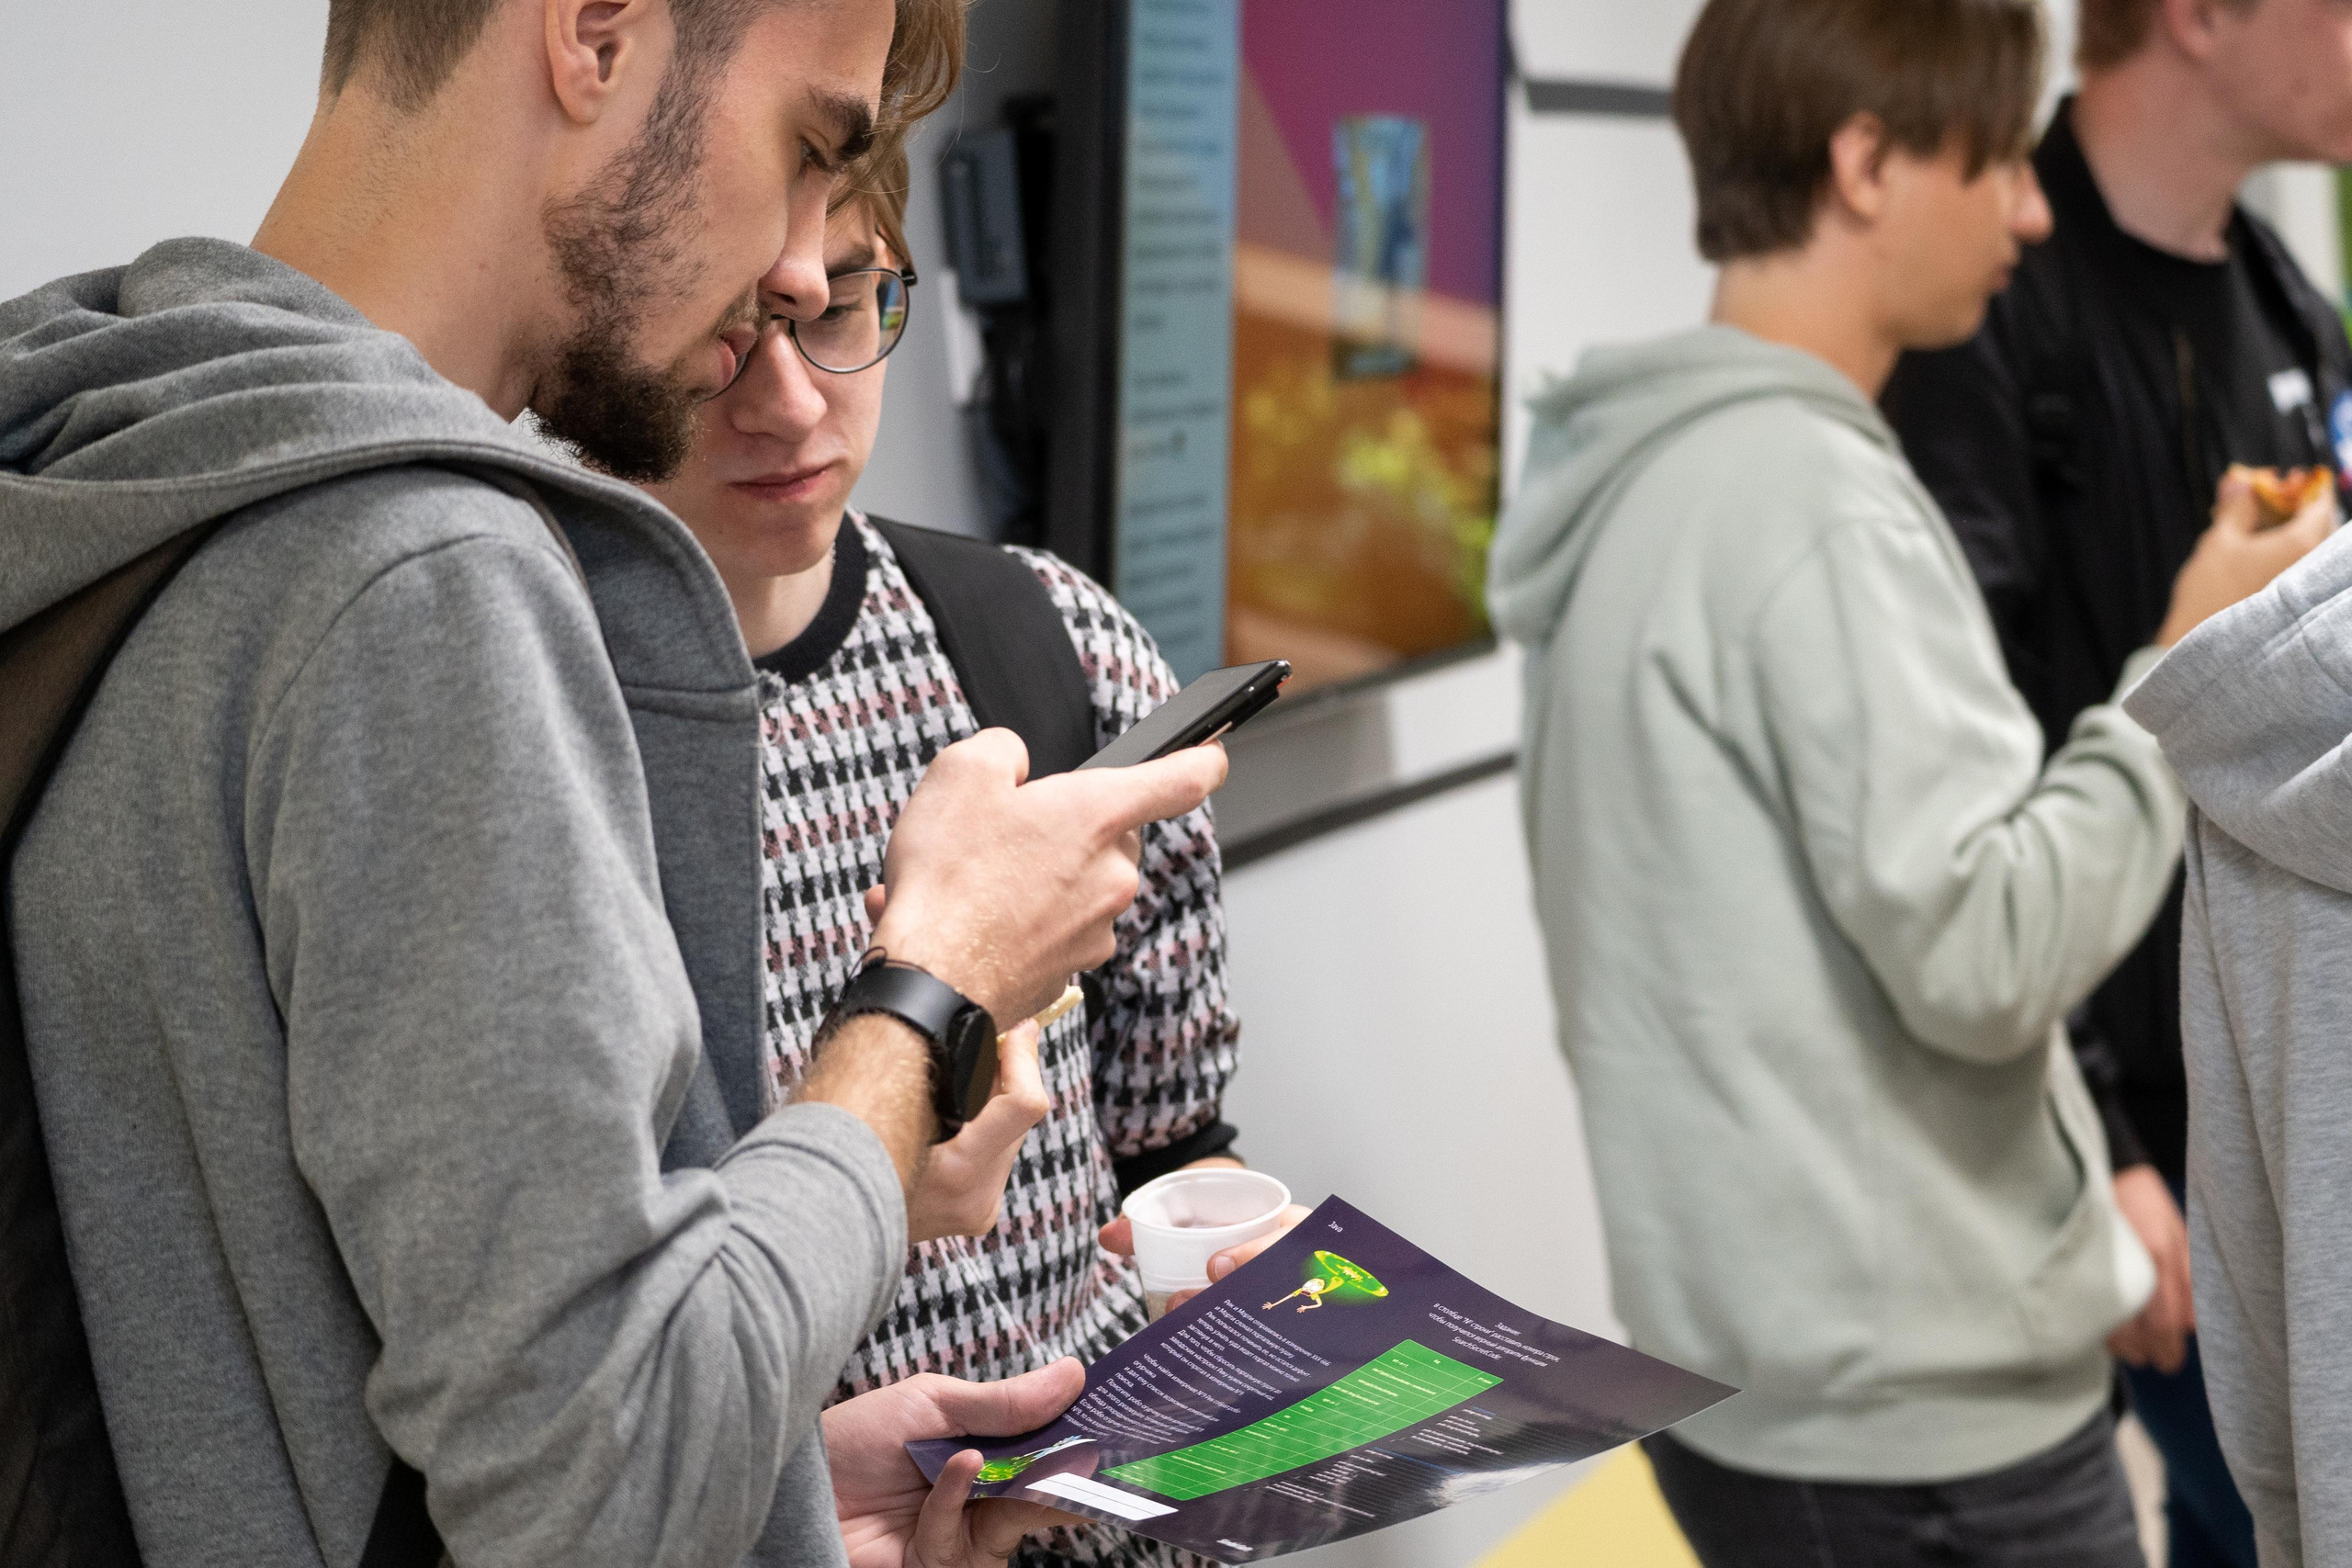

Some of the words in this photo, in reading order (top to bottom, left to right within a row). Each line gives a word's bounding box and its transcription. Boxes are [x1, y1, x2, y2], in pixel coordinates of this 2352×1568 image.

[1328, 1220, 1343, 1233] Java
[1218, 1308, 1236, 1321] Морти
[1224, 1299, 1235, 1308] Рик
[1238, 1309, 1254, 1321] Морти
[1187, 1325, 1210, 1340] заглянув
[1205, 1312, 1216, 1320] Рик
[1216, 1319, 1241, 1337] попытался
[1240, 1336, 1262, 1350] починить
[1275, 1358, 1294, 1369] остался
[1429, 1313, 1447, 1324] чтобы
[1474, 1337, 1498, 1347] верный
[1438, 1306, 1463, 1320] столбце
[1490, 1333, 1521, 1347] расставить
[1521, 1345, 1544, 1355] номера
[1160, 1342, 1182, 1359] который
[1187, 1361, 1207, 1375] спрятал
[1170, 1337, 1195, 1355] заводских
[1216, 1368, 1229, 1377] Рику
[1227, 1375, 1243, 1384] нужен
[1177, 1330, 1190, 1338] Для
[1189, 1337, 1201, 1348] того,
[1201, 1345, 1216, 1356] чтобы
[1214, 1355, 1235, 1370] сбросить
[1235, 1368, 1262, 1384] портальную
[1197, 1318, 1214, 1331] теперь
[1212, 1330, 1229, 1342] узнать
[1228, 1340, 1240, 1348] куда
[1252, 1355, 1270, 1366] портал
[1269, 1365, 1285, 1374] можно
[1283, 1373, 1300, 1382] только
[1133, 1360, 1157, 1378] огурчика
[1144, 1354, 1159, 1367] Чтобы
[1158, 1366, 1173, 1377] найти
[1106, 1378, 1131, 1398] Помогите
[1127, 1370, 1139, 1378] дал
[1137, 1377, 1148, 1385] ему
[1147, 1383, 1165, 1396] список
[1080, 1399, 1093, 1410] Если
[1089, 1393, 1106, 1406] обхода
[1096, 1386, 1108, 1394] для
[1106, 1393, 1121, 1404] этого
